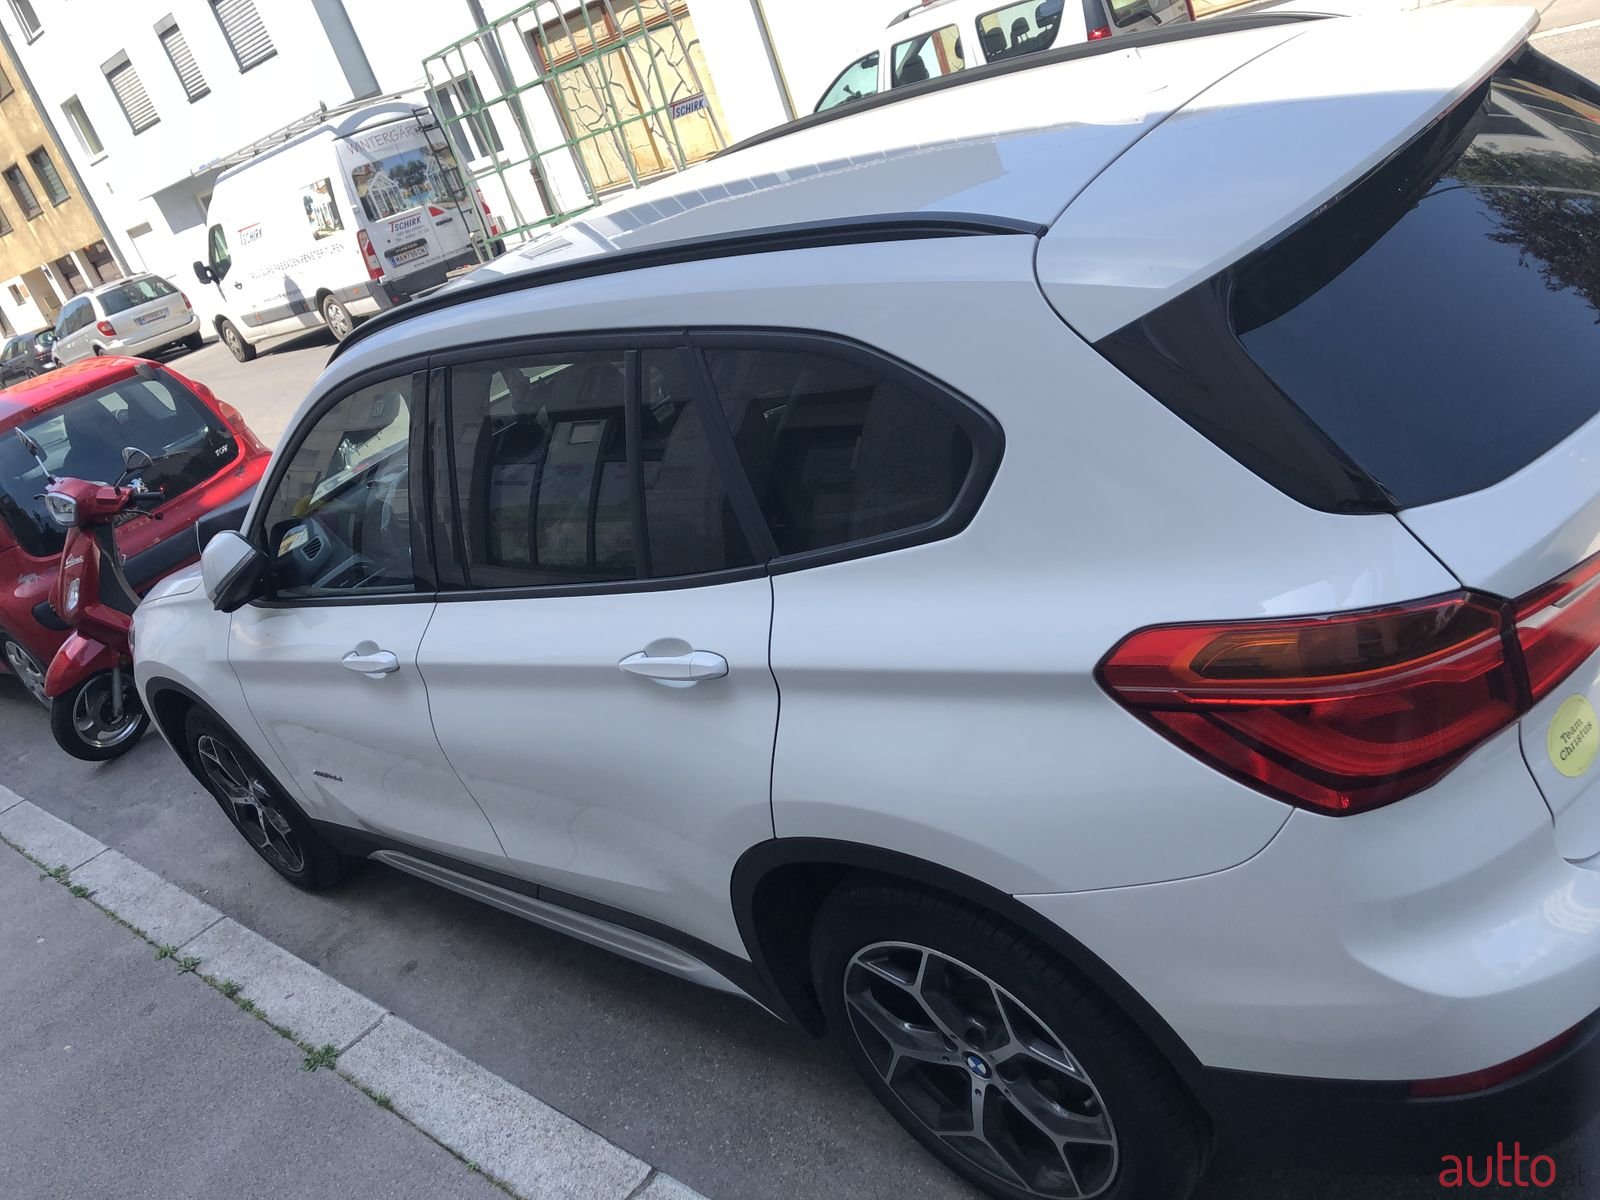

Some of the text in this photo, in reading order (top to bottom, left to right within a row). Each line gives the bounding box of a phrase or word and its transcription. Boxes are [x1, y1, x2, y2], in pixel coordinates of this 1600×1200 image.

[669, 94, 704, 119] TSCHIRK
[388, 212, 422, 232] TSCHIRK
[1560, 718, 1583, 743] Team
[1560, 721, 1592, 760] Christus
